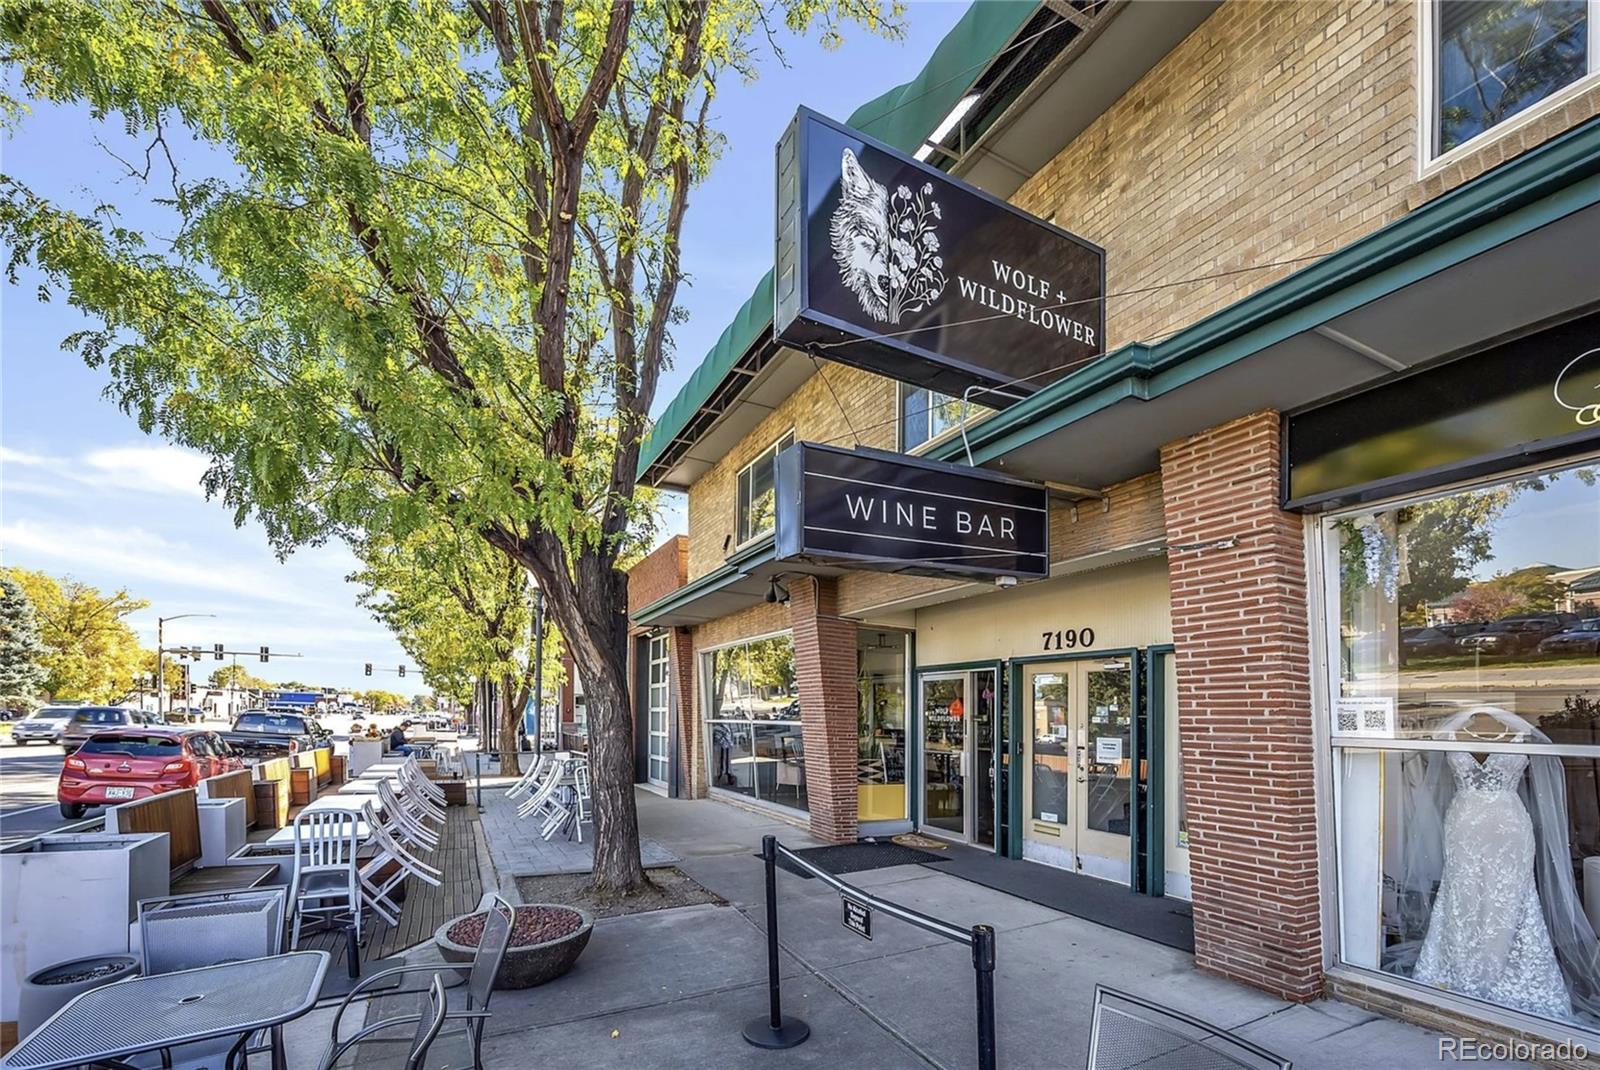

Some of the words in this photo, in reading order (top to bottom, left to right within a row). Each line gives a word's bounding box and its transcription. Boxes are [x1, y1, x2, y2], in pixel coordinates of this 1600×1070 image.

[992, 259, 1050, 299] WOLF
[1057, 291, 1067, 304] +
[957, 276, 1096, 347] WILDFLOWER
[845, 494, 937, 530] WINE
[956, 511, 1016, 540] BAR
[1042, 627, 1095, 651] 7190
